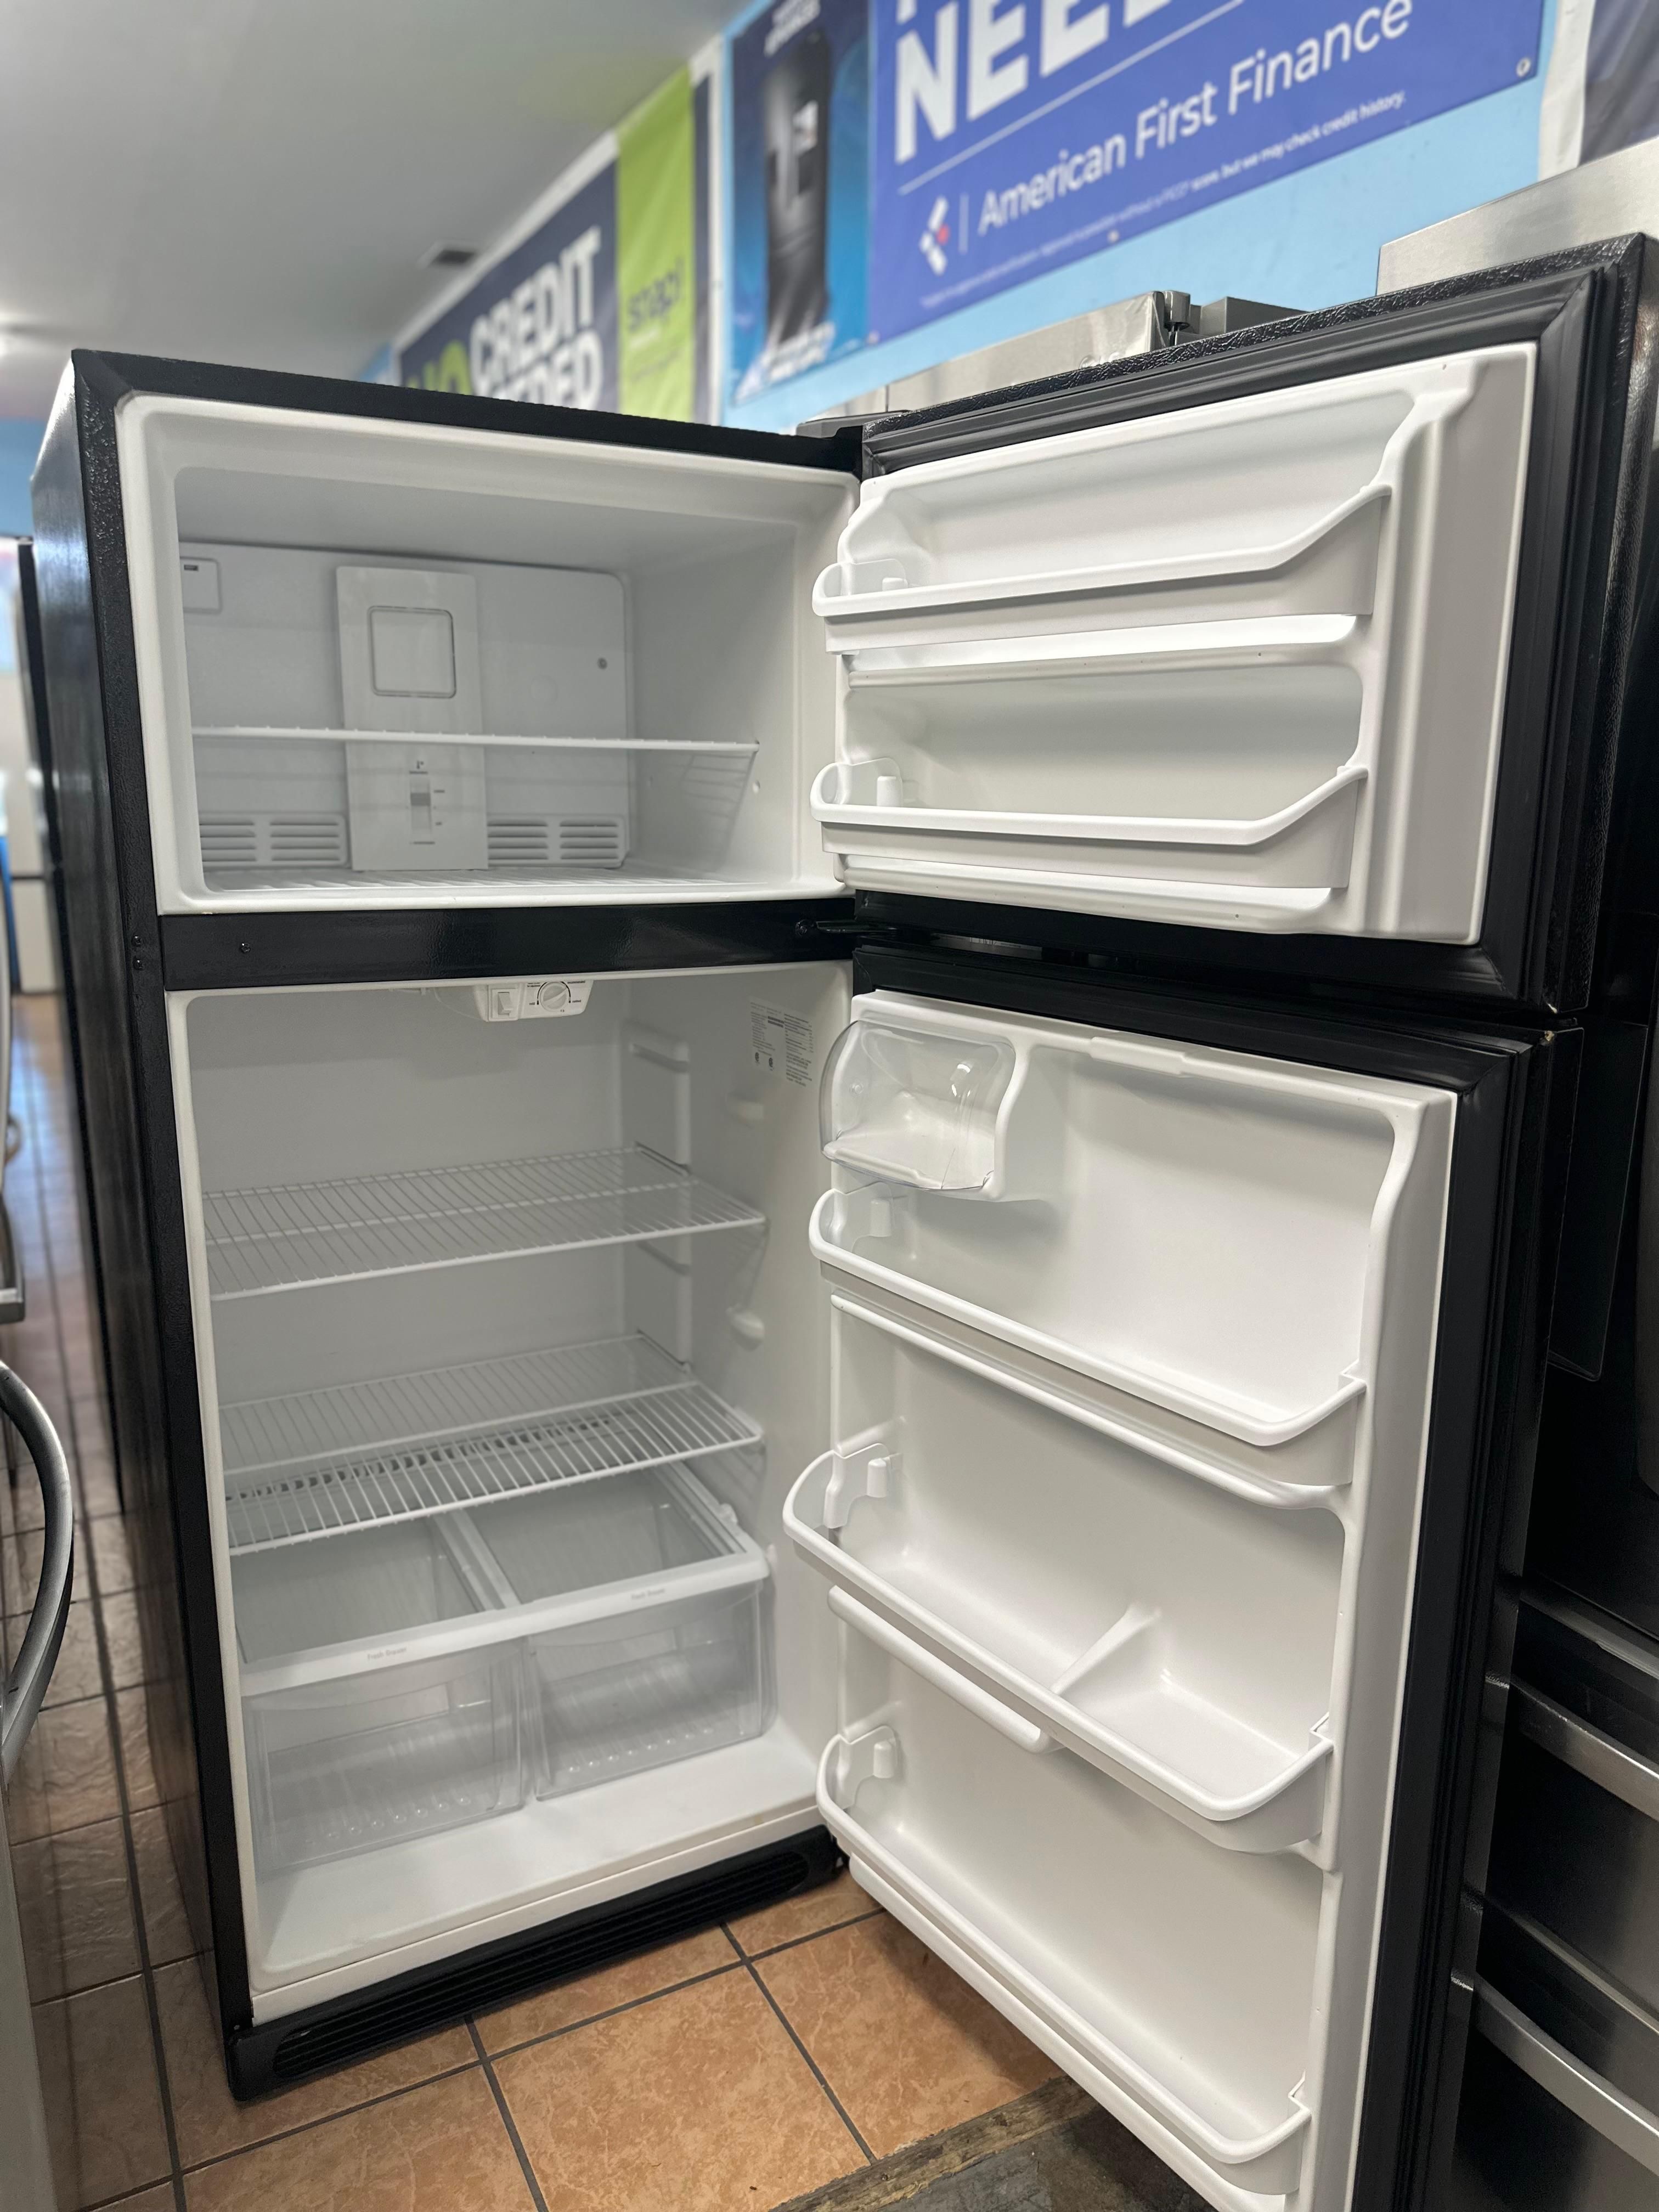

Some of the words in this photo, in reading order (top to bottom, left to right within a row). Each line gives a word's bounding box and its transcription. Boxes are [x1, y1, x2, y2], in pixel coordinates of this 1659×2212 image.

[894, 0, 1173, 166] NEE
[978, 134, 1125, 236] American
[1135, 82, 1217, 160] First
[1228, 0, 1413, 115] Finance
[1322, 109, 1358, 136] credit
[470, 224, 601, 399] CREDIT
